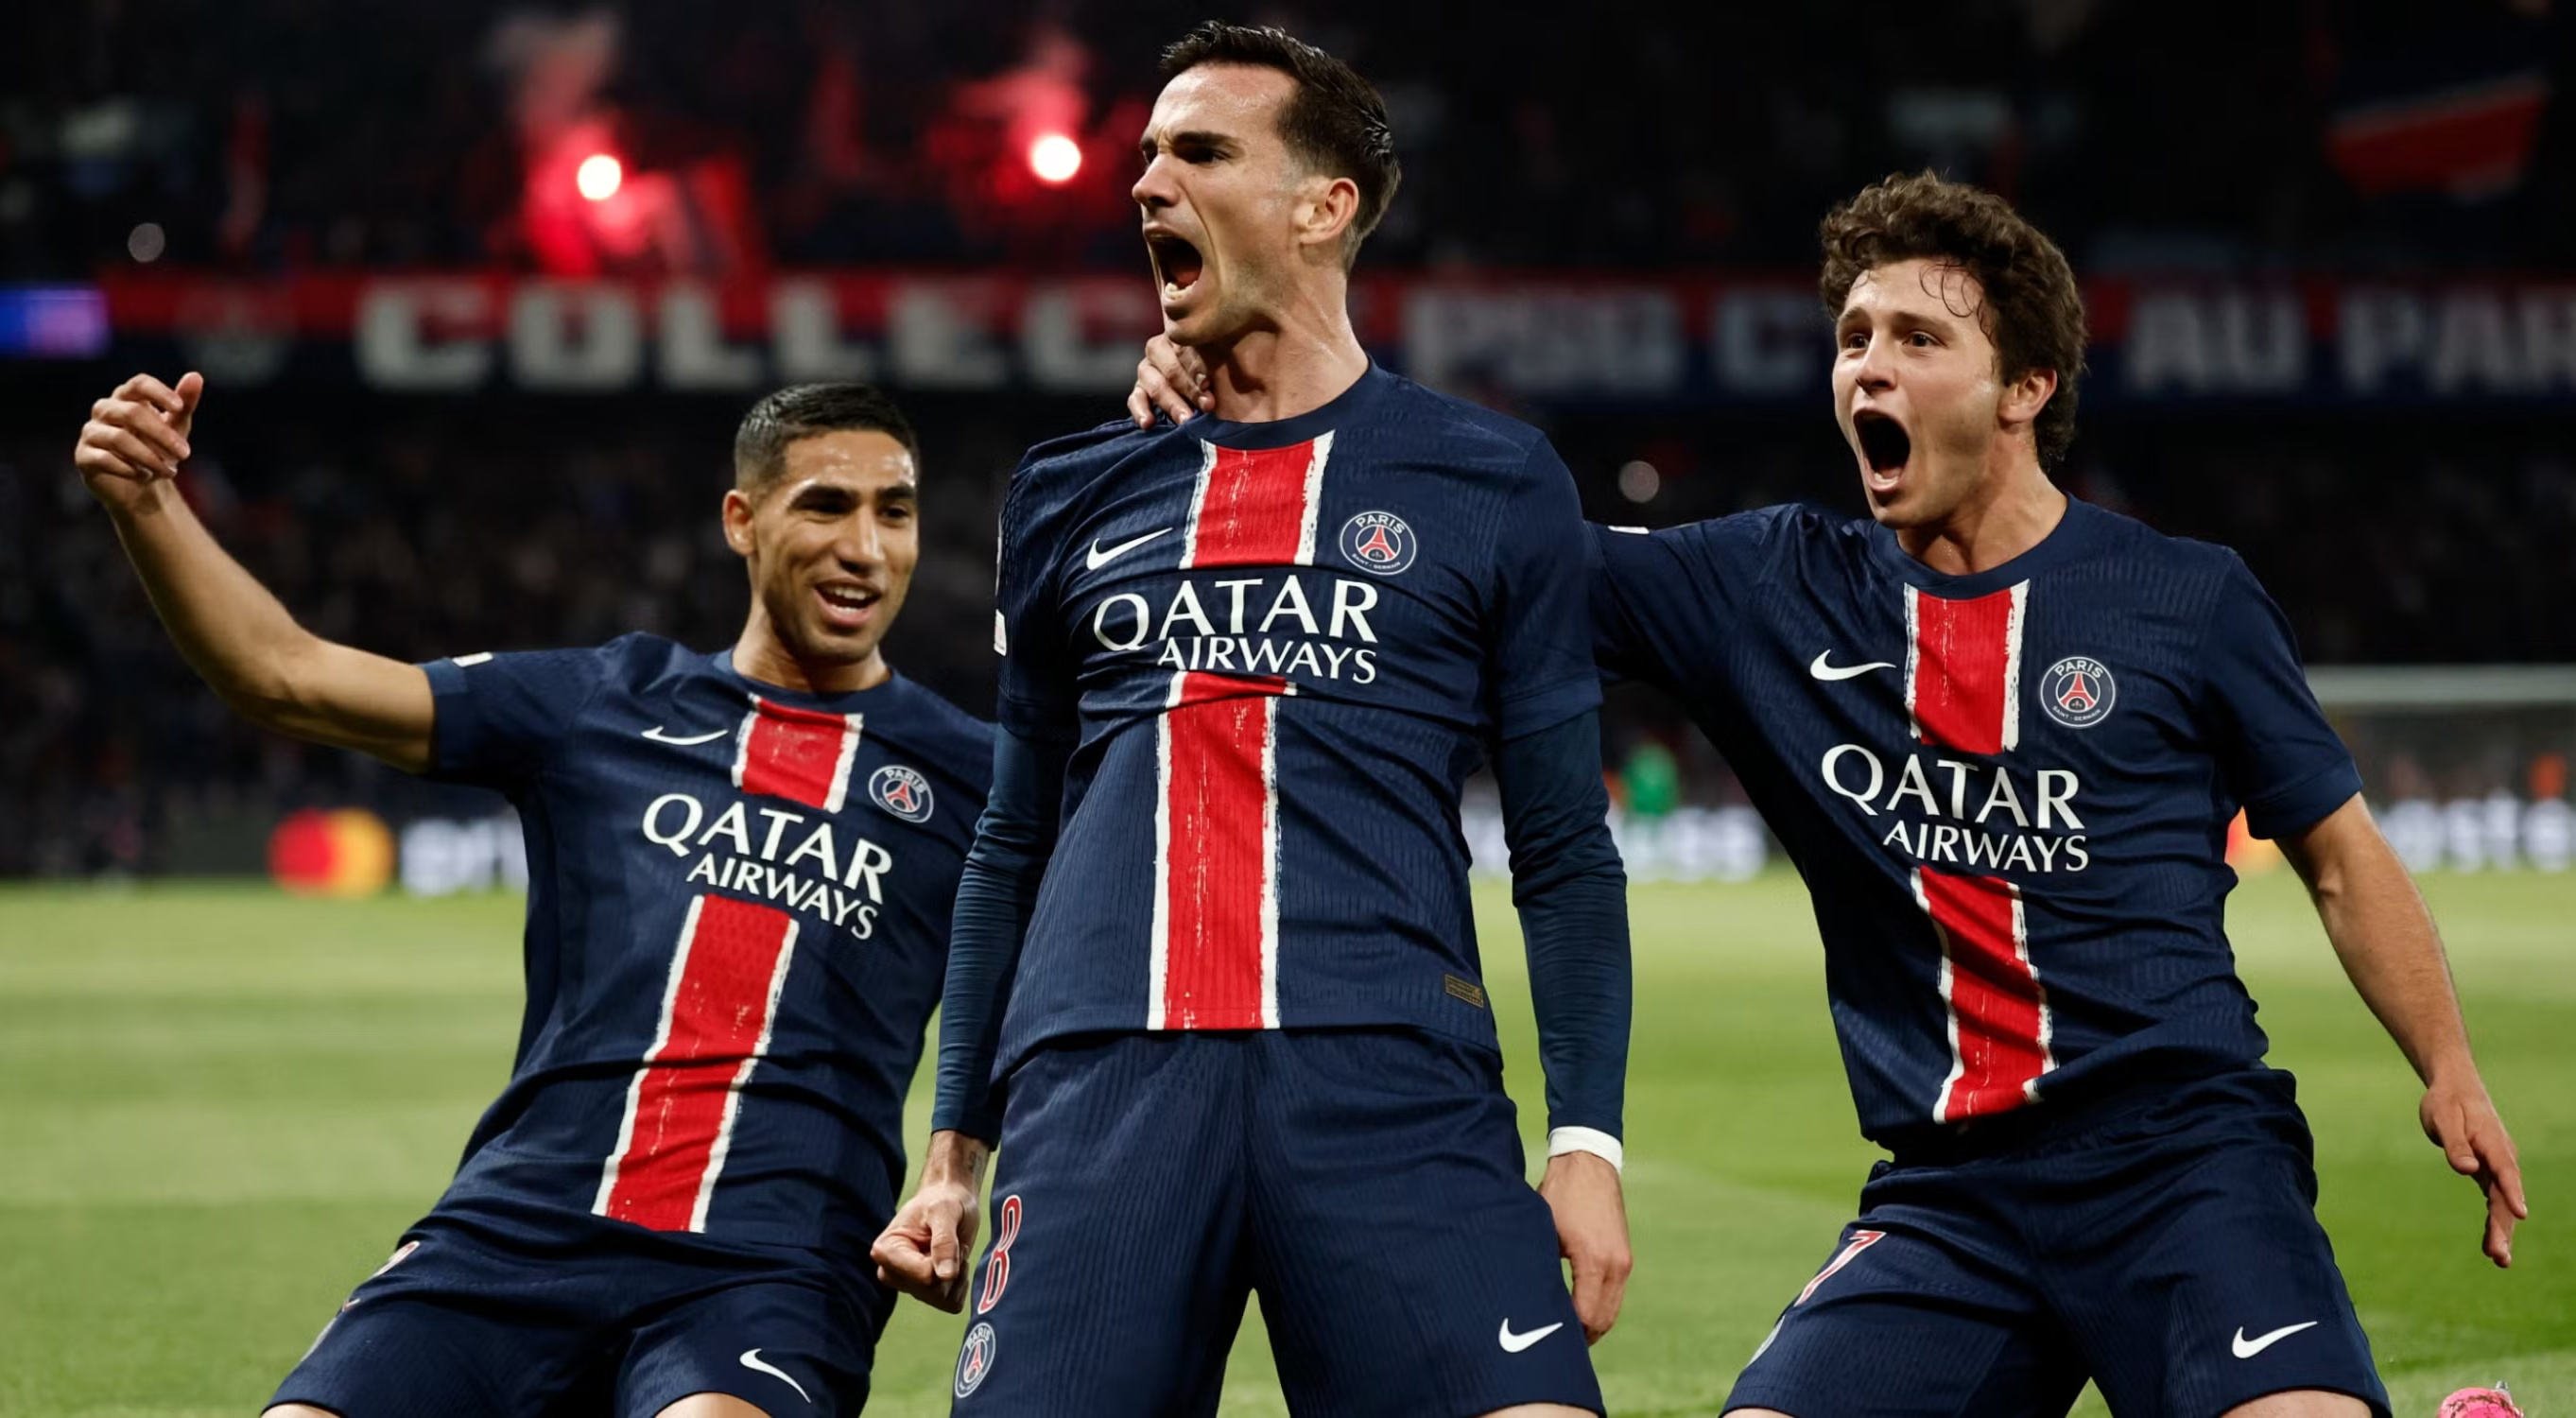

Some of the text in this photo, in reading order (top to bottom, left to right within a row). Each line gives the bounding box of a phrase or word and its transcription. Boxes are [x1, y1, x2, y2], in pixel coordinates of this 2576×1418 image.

[2125, 280, 2307, 397] AU
[1355, 514, 1406, 534] PARIS
[1093, 574, 1379, 652] QATAR
[1156, 635, 1377, 684] AIRWAYS
[2054, 660, 2104, 679] PARIS
[1821, 743, 2085, 830] QATAR
[642, 792, 892, 905] QATAR
[1882, 820, 2089, 873] AIRWAYS
[685, 852, 878, 941] AIRWAYS
